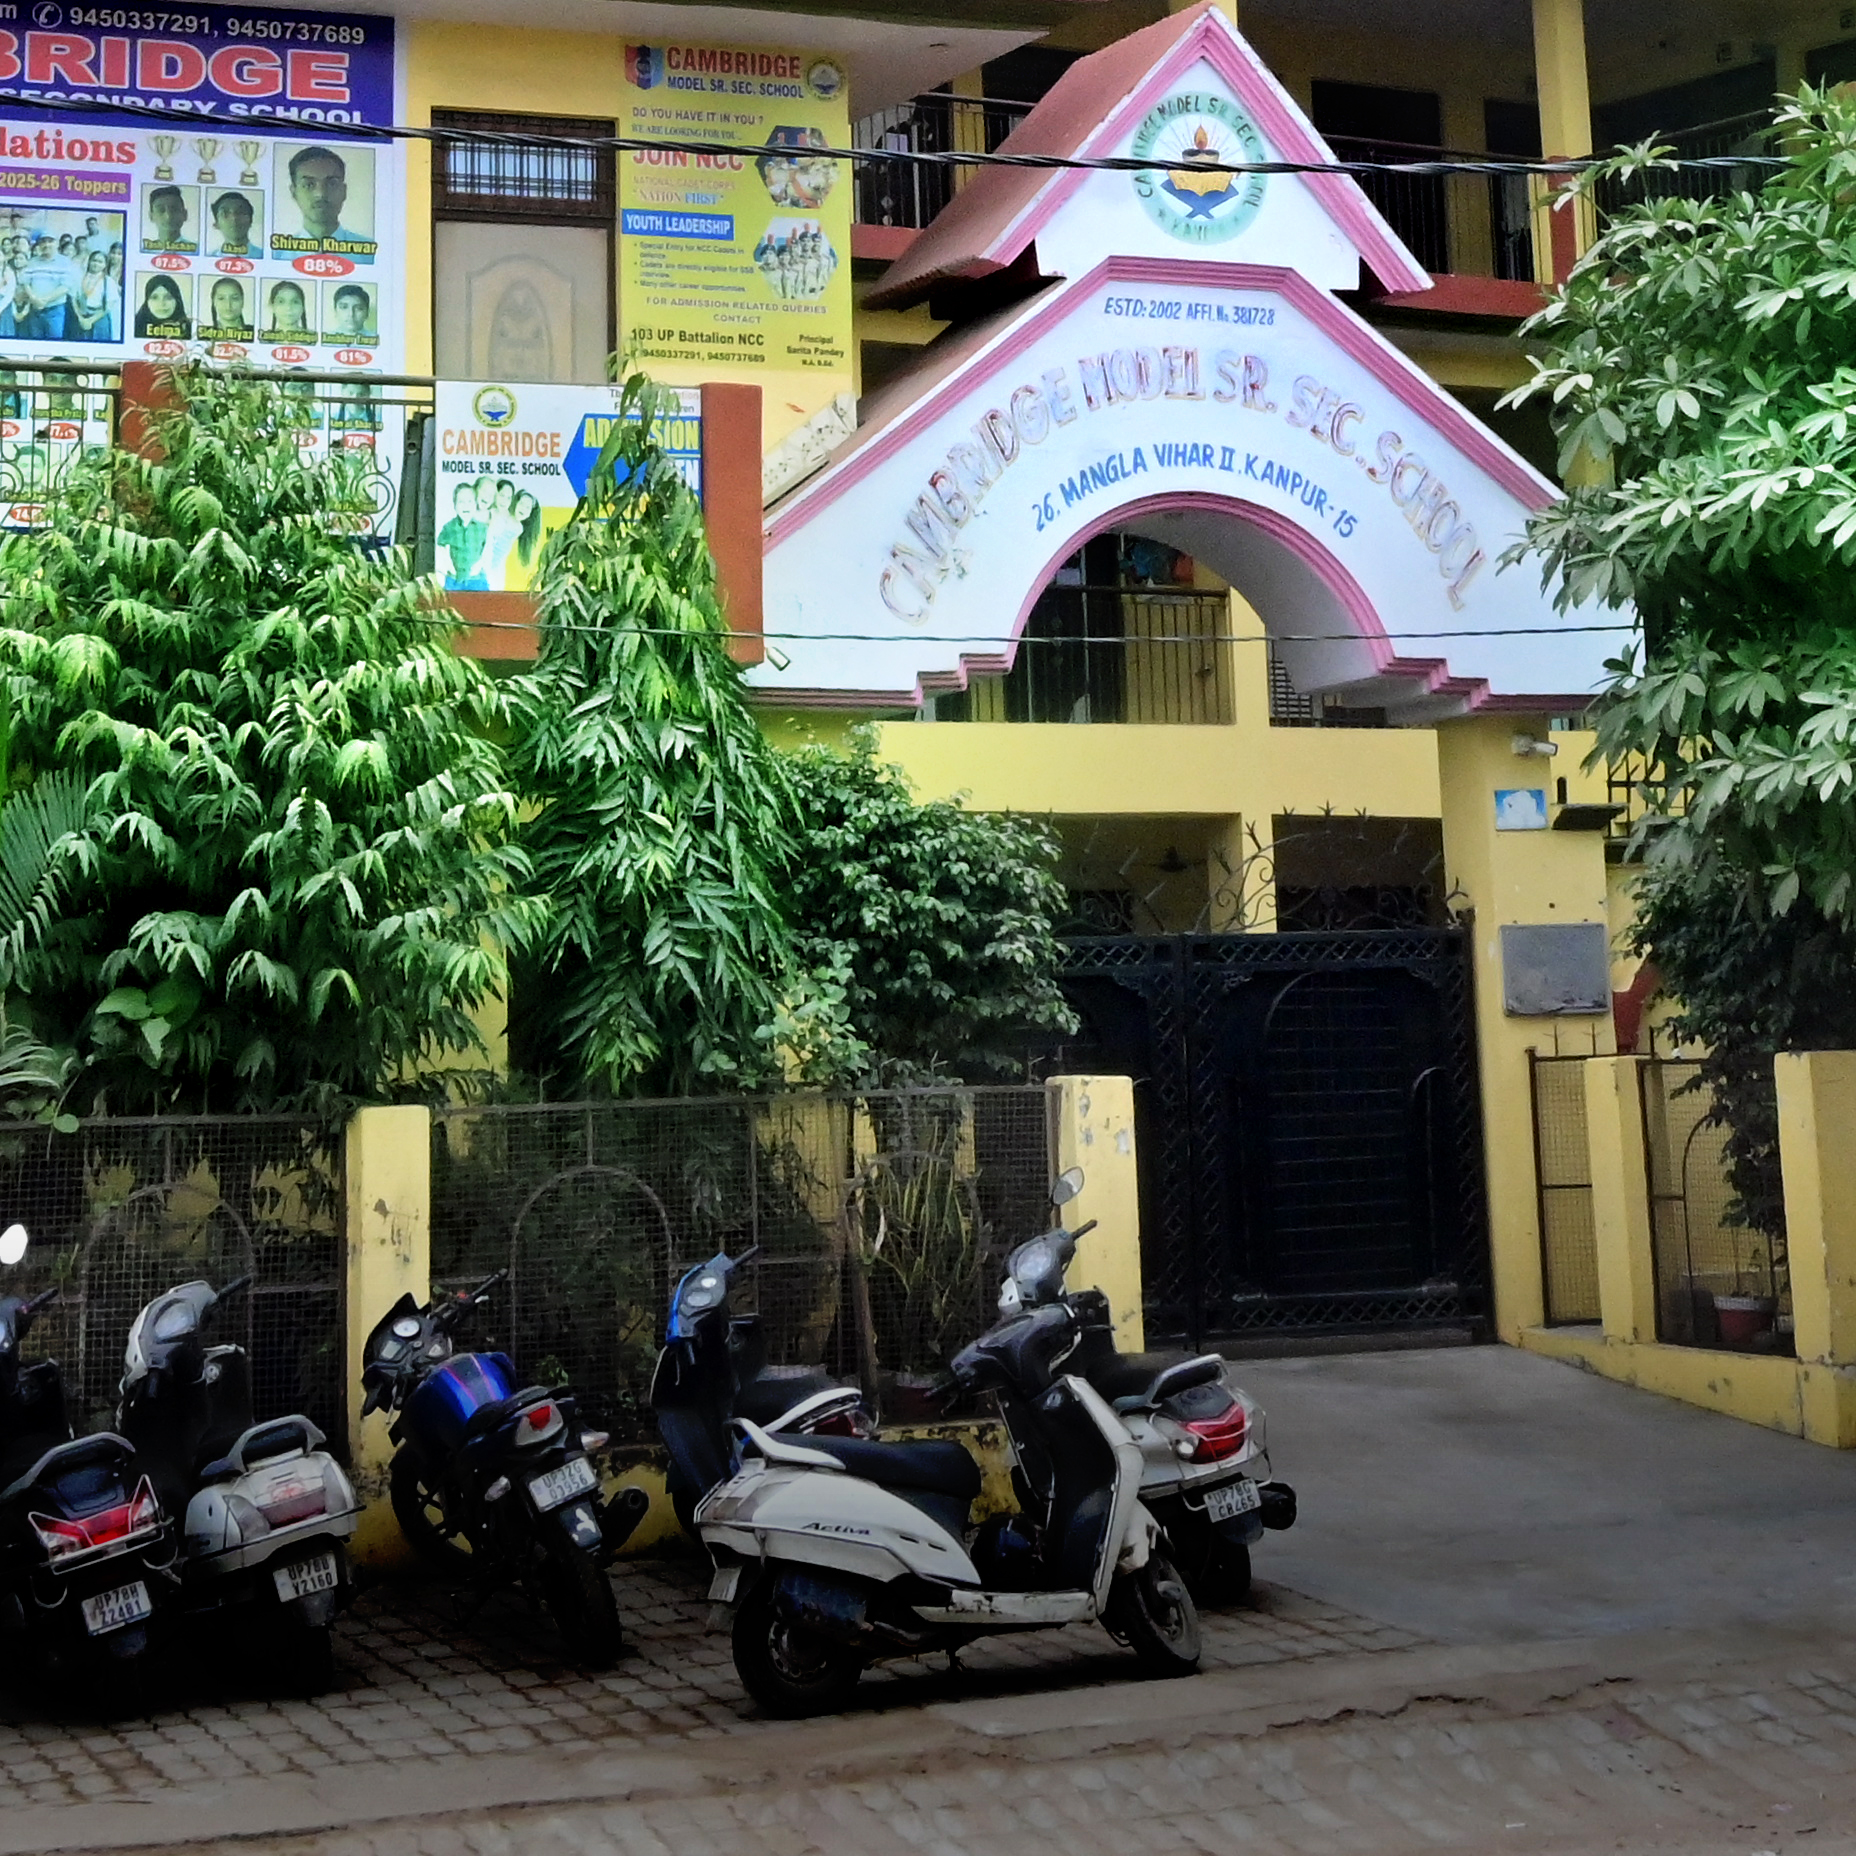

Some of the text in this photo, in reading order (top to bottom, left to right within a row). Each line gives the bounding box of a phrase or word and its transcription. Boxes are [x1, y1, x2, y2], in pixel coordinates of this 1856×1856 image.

[70, 6, 220, 39] 9450337291,
[226, 17, 366, 45] 9450737689
[667, 46, 801, 79] CAMBRIDGE
[667, 76, 805, 99] MODEL SR. SEC. SCHOOL
[632, 106, 647, 118] DO
[651, 108, 672, 119] YOU
[675, 111, 703, 122] HAVE
[705, 112, 717, 123] IT
[719, 113, 731, 124] IN
[734, 114, 756, 126] YOU
[632, 148, 745, 171] JOIN NCC
[64, 175, 128, 196] Toppers
[625, 214, 731, 235] YOUTH LEADERSHIP
[272, 235, 378, 255] Shivam Kharwar
[304, 258, 343, 273] 88%
[647, 297, 827, 315] FOR ADMISSION RELATED QUERIES
[1233, 306, 1276, 325] 381728
[713, 313, 762, 325] CONTACT
[631, 328, 764, 346] 103 UP Battalion NCC
[799, 334, 833, 346] Principal
[814, 347, 844, 359] Pandey
[442, 429, 561, 457] CAMBRIDGE
[585, 418, 699, 450] ADSION
[442, 460, 561, 476] MODEL SR. SEC. SCHOOL
[1059, 446, 1148, 508] MANGLA
[1153, 442, 1214, 468] VIHAR
[879, 346, 1486, 627] CAMBRIDGE MODEL SR. SEC. SCHOOL
[800, 1521, 872, 1535] Activa
